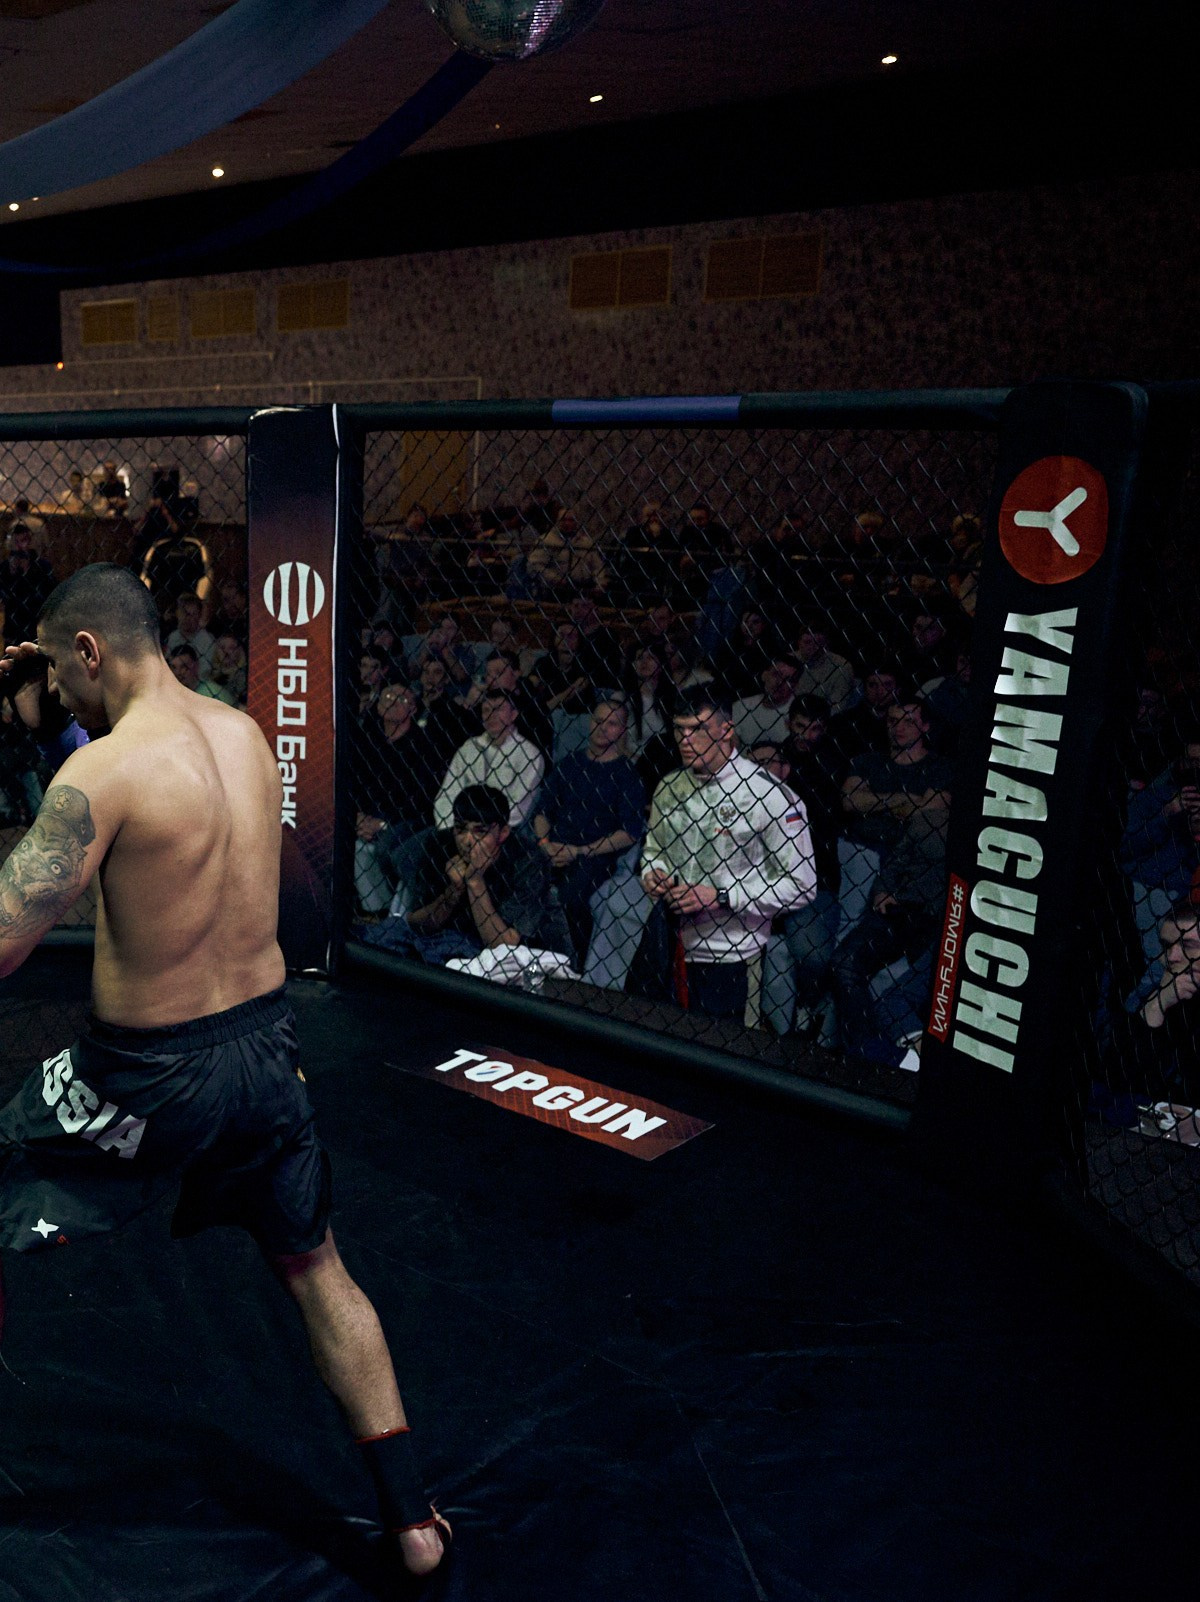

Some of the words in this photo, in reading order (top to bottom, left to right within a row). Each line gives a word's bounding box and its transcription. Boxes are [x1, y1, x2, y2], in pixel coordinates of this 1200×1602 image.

[277, 637, 308, 727] НБД
[276, 734, 307, 829] Банк
[952, 606, 1079, 1075] YAMAGUCHI
[42, 1048, 148, 1160] SSIA
[434, 1048, 668, 1141] TOPGUN
